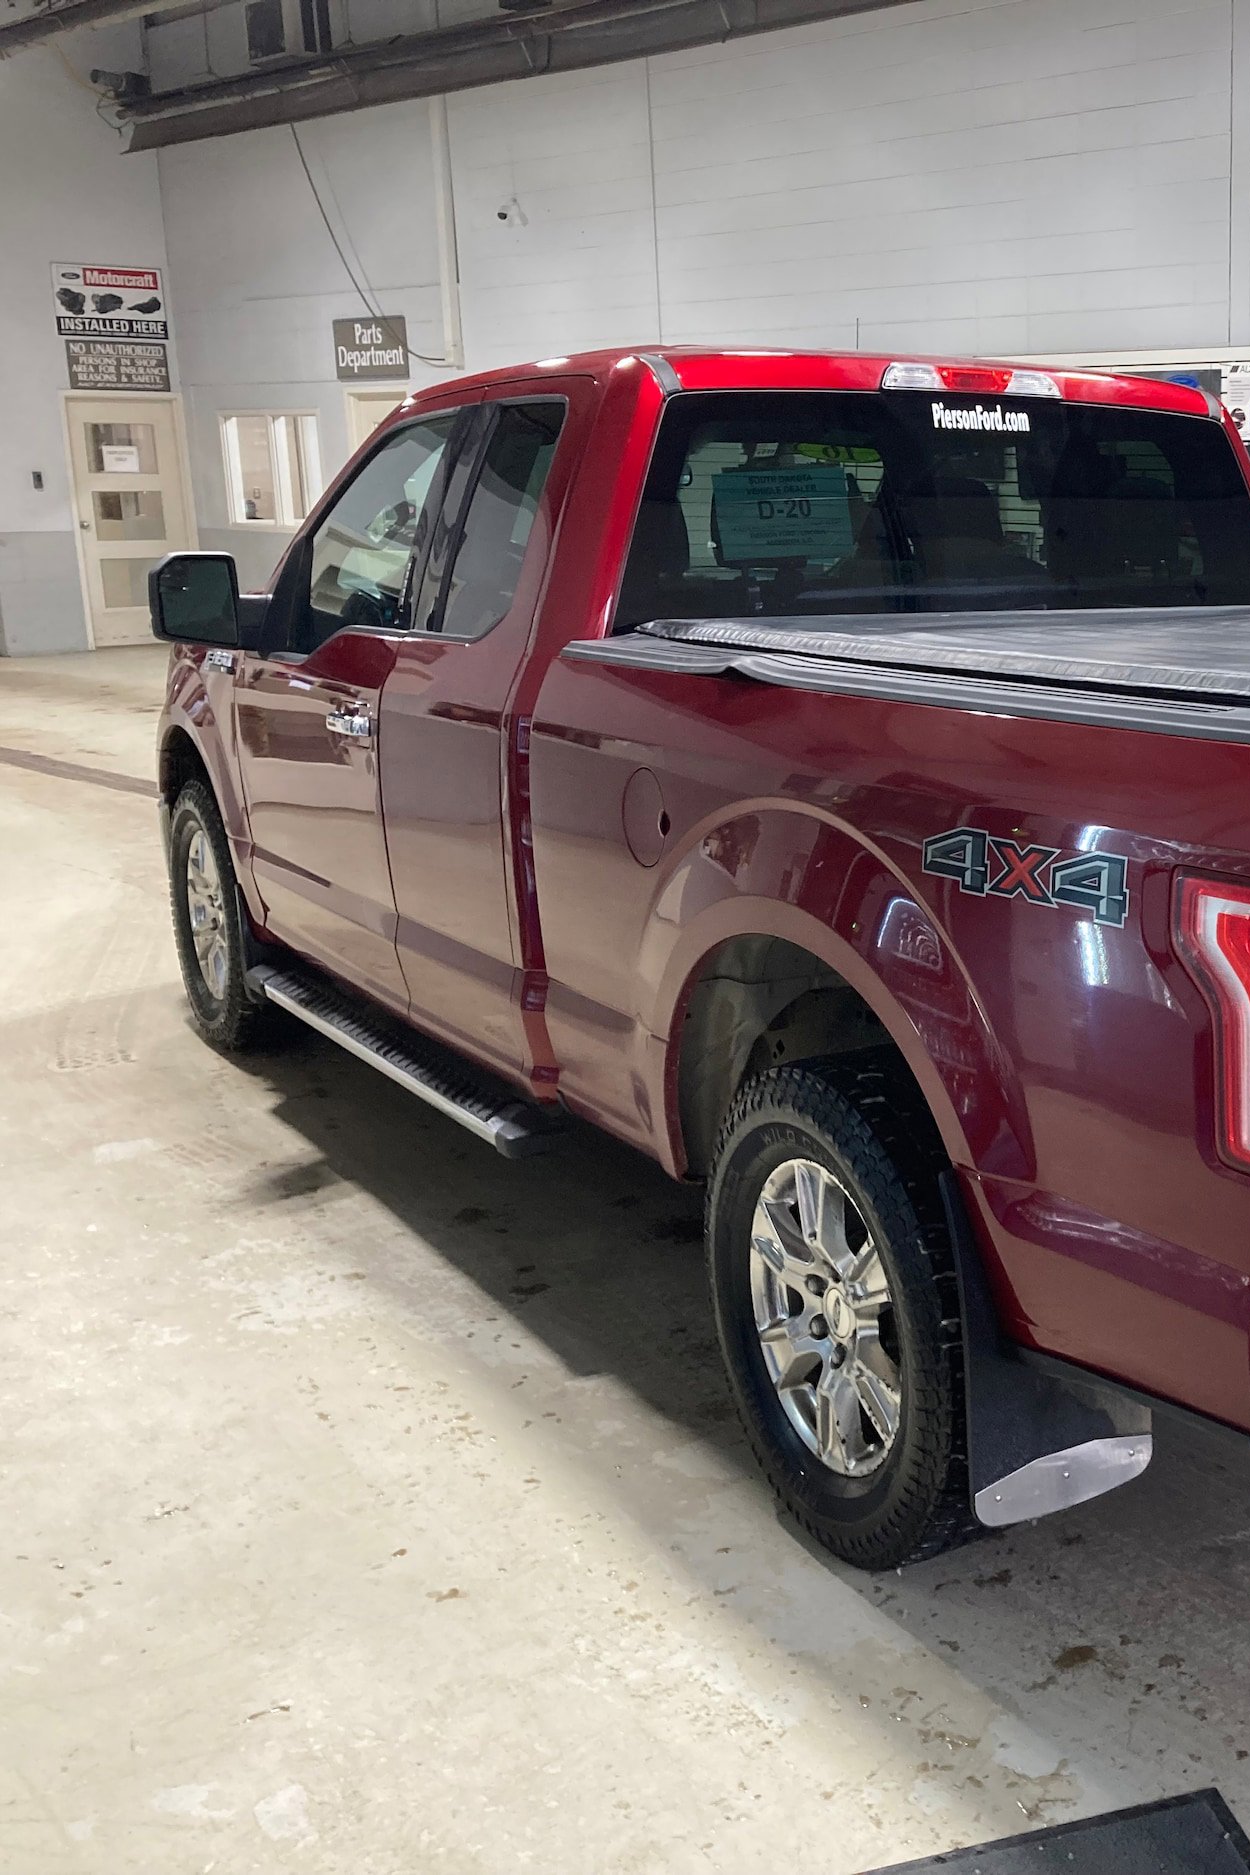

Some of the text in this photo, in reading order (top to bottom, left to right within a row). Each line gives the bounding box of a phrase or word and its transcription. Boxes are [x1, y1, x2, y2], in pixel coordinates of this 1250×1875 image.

[85, 270, 156, 288] Motorcraft
[61, 318, 166, 333] INSTALLED HERE
[354, 323, 383, 344] Parts
[69, 343, 163, 356] NO UNAUTHORIZED
[79, 357, 157, 367] PERSONS IN SHOP
[338, 345, 404, 373] Department
[72, 364, 166, 375] AREA FOR INSURANCE
[77, 373, 117, 381] REASONS
[931, 402, 1030, 431] PiersonFord.com
[749, 474, 814, 484] SOUTH DAKOTA
[783, 484, 816, 493] DEALER
[758, 498, 812, 519] D-20
